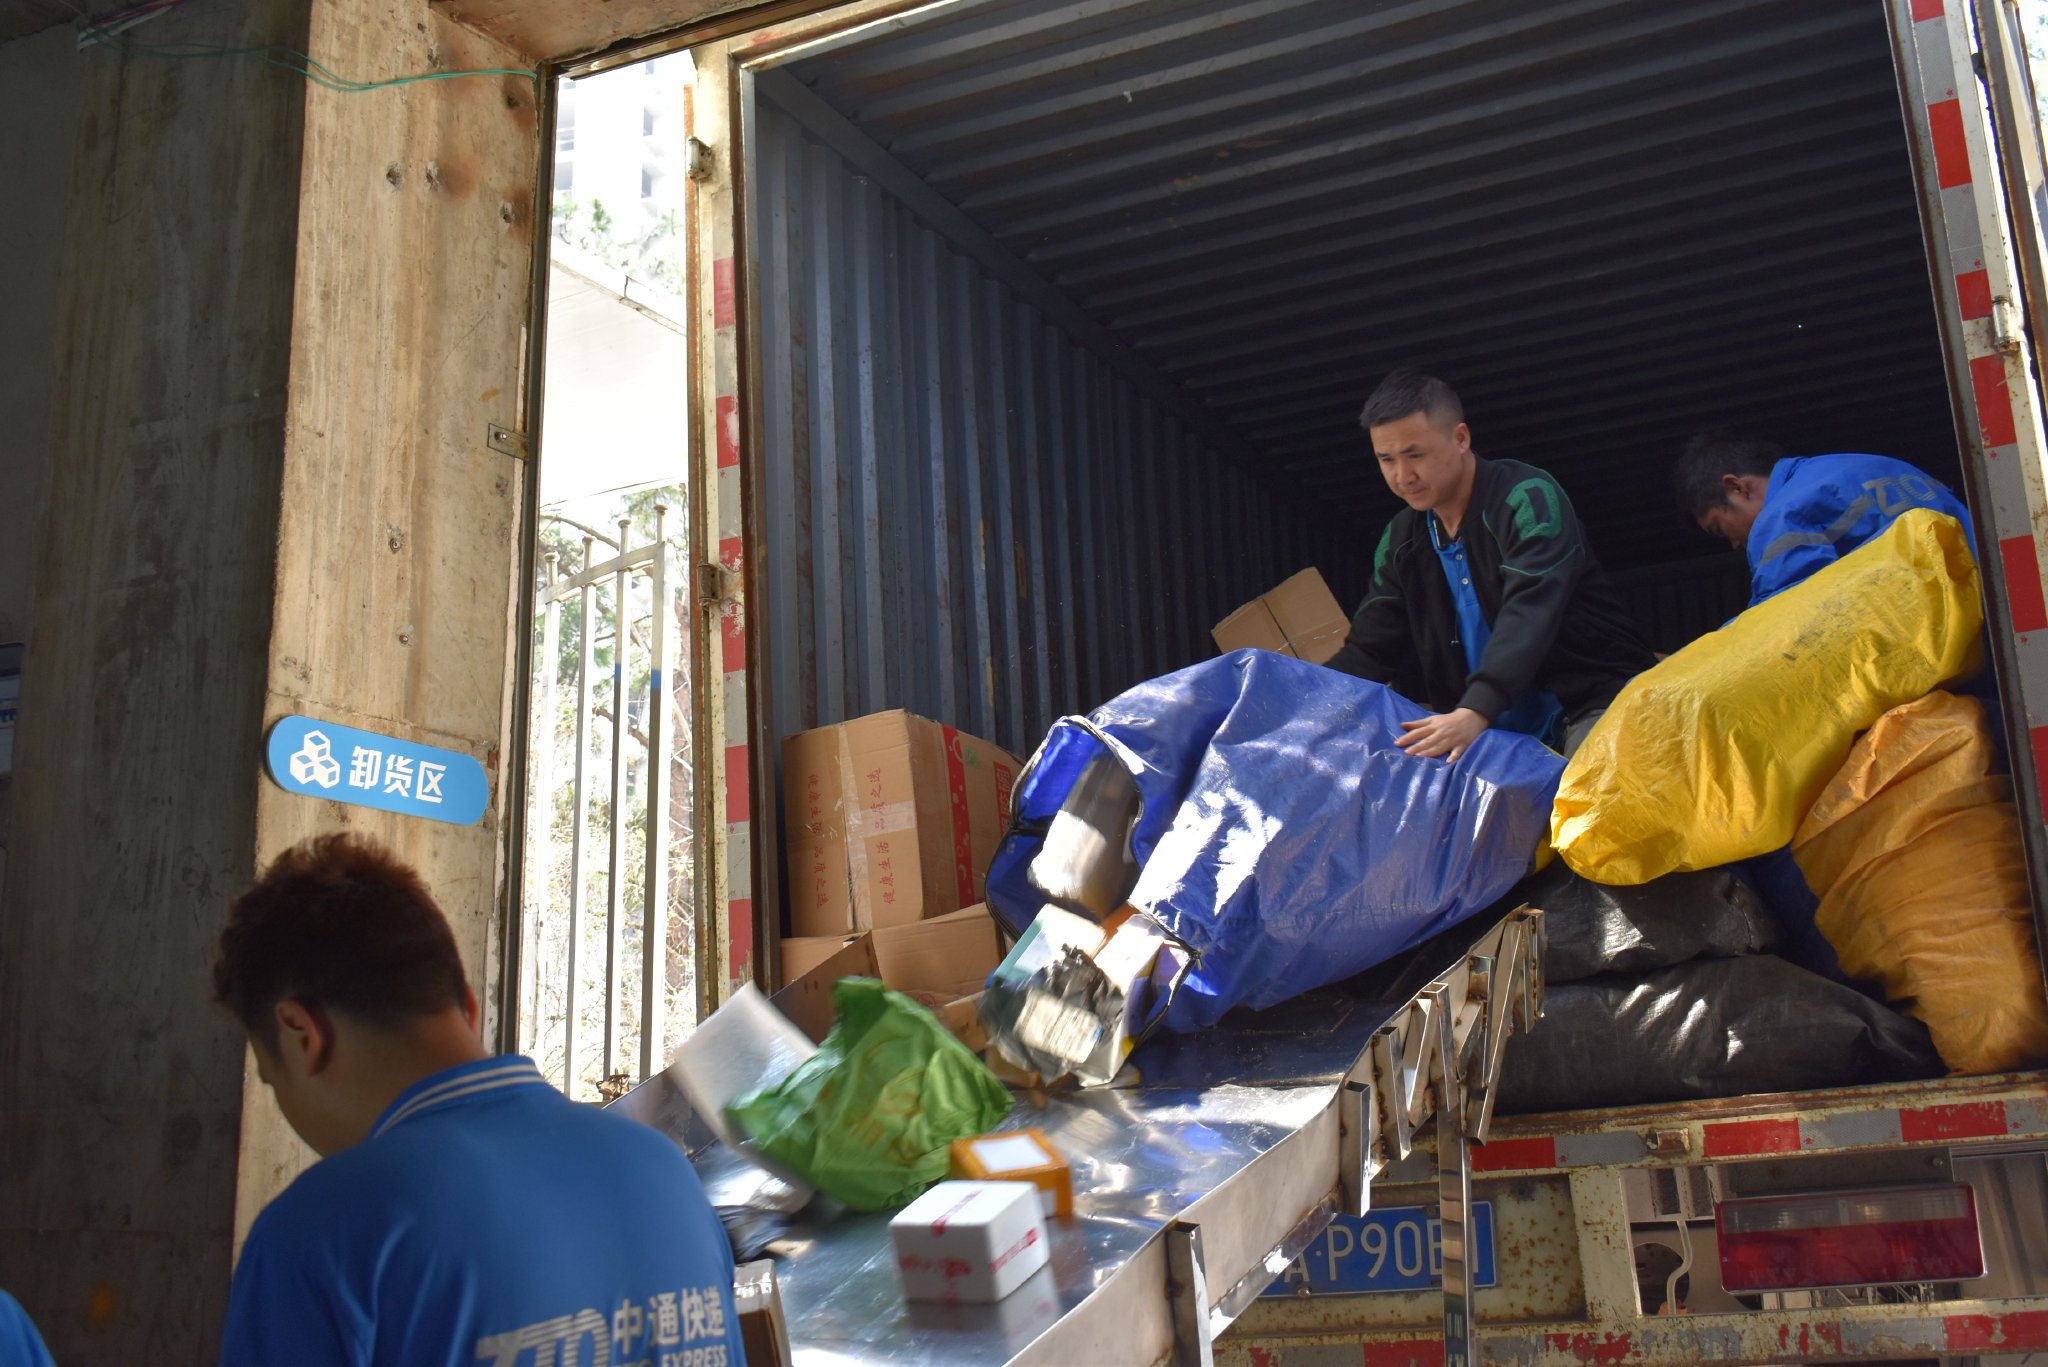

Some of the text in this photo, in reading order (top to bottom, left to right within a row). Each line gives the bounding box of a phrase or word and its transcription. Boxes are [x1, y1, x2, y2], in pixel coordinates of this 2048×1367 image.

[349, 745, 448, 804] 卸货区
[876, 841, 897, 905] 健康生活
[613, 1285, 726, 1355] 中通快递
